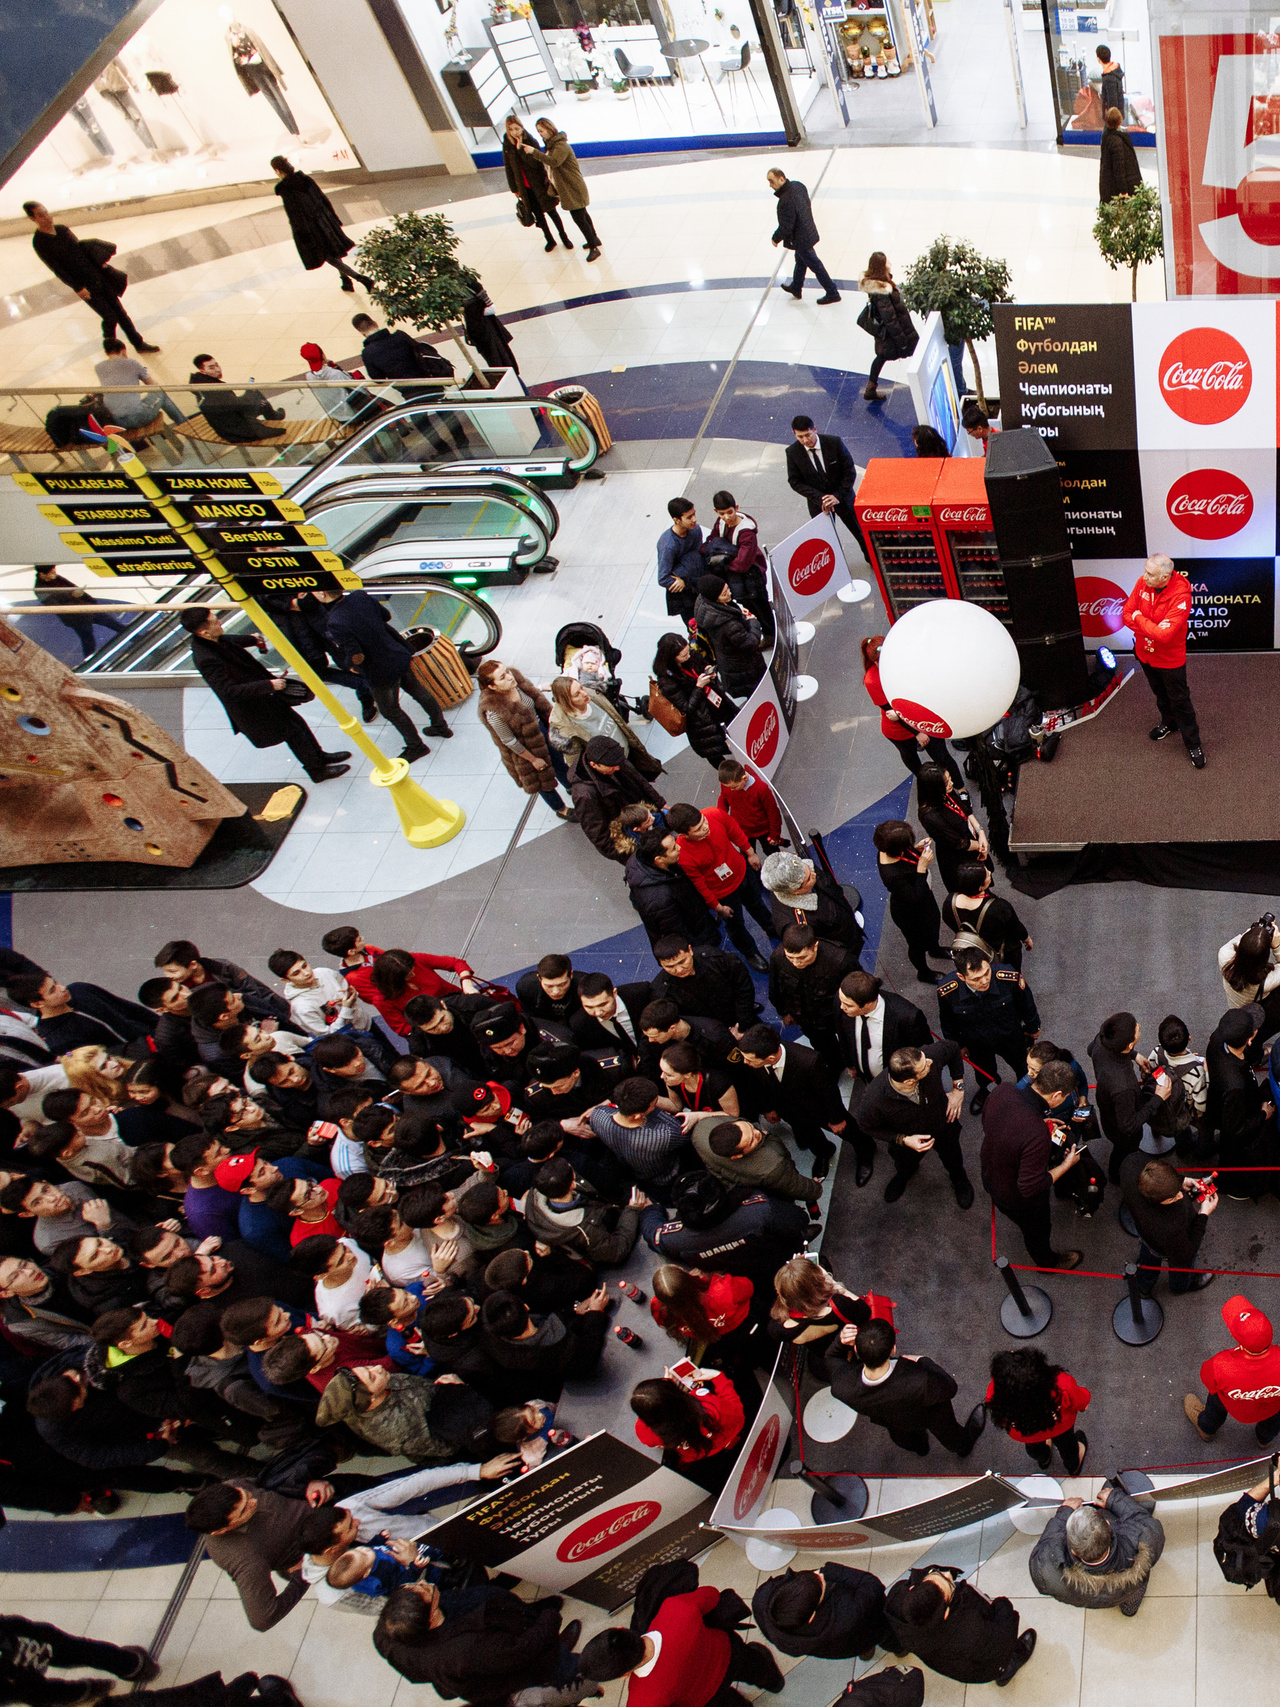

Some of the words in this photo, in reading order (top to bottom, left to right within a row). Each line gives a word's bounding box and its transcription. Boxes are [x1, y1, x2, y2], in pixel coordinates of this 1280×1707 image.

[1016, 338, 1098, 355] Футболдан
[1018, 360, 1058, 374] Әлем
[1163, 360, 1249, 391] Coca-Cola
[1019, 382, 1112, 396] Чемпионаты
[45, 479, 129, 490] PULL&BEAR
[166, 478, 211, 489] ZARA
[211, 478, 252, 489] HOME
[193, 503, 267, 518] MANGO
[1171, 494, 1249, 516] Coca-Cola
[73, 508, 152, 520] STARBUCKS
[862, 507, 908, 522] Coca-Cola
[940, 506, 987, 523] Coca-Cola
[1065, 510, 1122, 520] пионаты
[90, 535, 144, 547] Massimo
[144, 534, 177, 545] Dutti
[219, 530, 285, 543] Bershka
[116, 559, 196, 572] stradivarius
[247, 557, 300, 568] O'STIN
[791, 546, 831, 587] Coca-Cola
[262, 576, 318, 590] OYSHO
[1191, 594, 1262, 605] ПИОНАТА
[1209, 608, 1228, 617] ПО
[1187, 619, 1231, 629] ТБОЛУ
[750, 709, 777, 761] Coca-Cola
[499, 1474, 603, 1535] Чемпионаты
[519, 1517, 562, 1543] Туры
[566, 1502, 652, 1560] Coca-Cola
